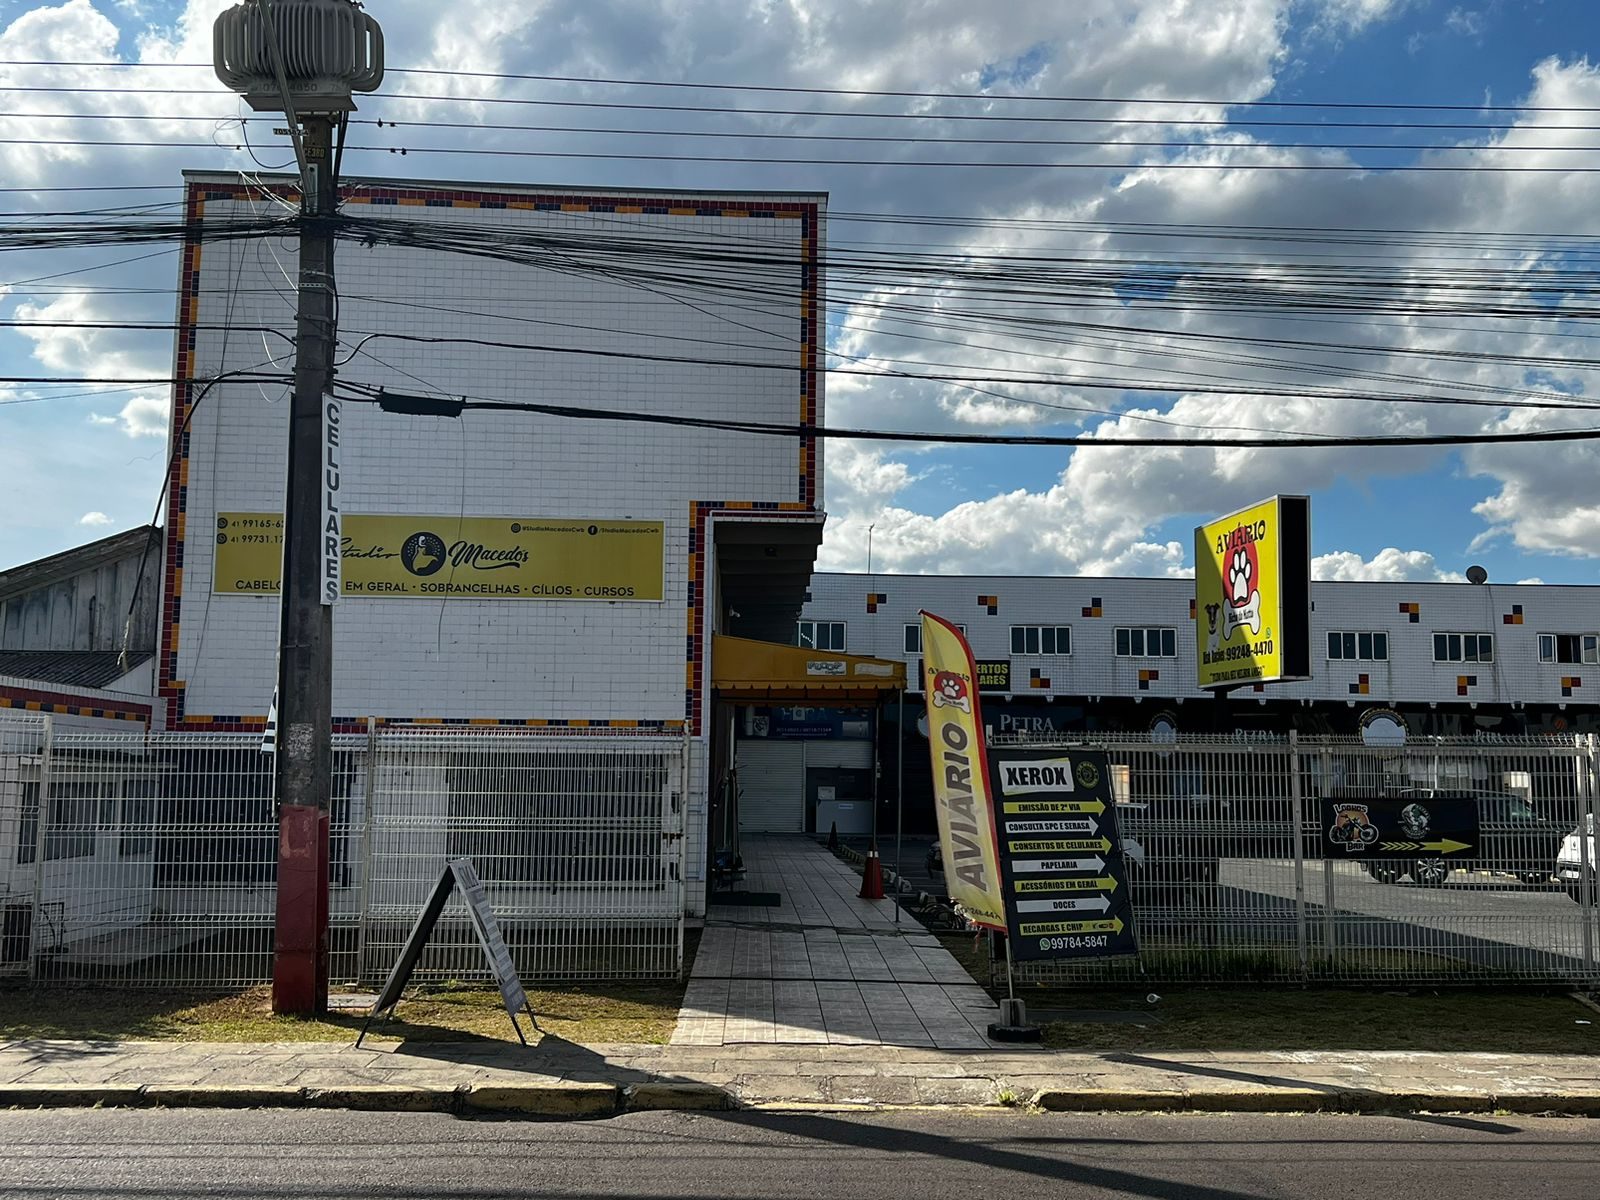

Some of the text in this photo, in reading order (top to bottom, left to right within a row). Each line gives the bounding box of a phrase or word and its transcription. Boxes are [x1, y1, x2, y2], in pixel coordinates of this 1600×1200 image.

[325, 402, 341, 601] CELULARES
[1215, 519, 1266, 554] AVIÁRIO
[345, 581, 363, 590] EM
[367, 581, 408, 592] GERAL
[420, 582, 520, 594] SOBRANCELHAS
[532, 583, 573, 595] CÍLIOS
[584, 586, 634, 597] CURSOS
[1226, 640, 1273, 661] 99248-4470
[976, 663, 1009, 675] ERTOS
[999, 713, 1055, 732] PETRA
[1005, 766, 1068, 786] XEROX
[939, 722, 987, 892] AVIÁRIO
[1018, 802, 1050, 812] EMISSÃO
[1050, 803, 1059, 811] DE
[1069, 803, 1081, 811] VIA
[1008, 823, 1043, 831] CONSULTA
[1065, 822, 1091, 830] SERASA
[1013, 840, 1102, 850] CONSERTOS DE CELULARES
[1040, 861, 1078, 869] PAPELARIA
[1020, 880, 1098, 891] ACESSÓRIOS EM GERAL
[1053, 900, 1076, 909] DOCES
[1022, 924, 1060, 934] RECARGAS
[1067, 923, 1084, 932] CHIP
[1050, 935, 1108, 950] 99784-5847
